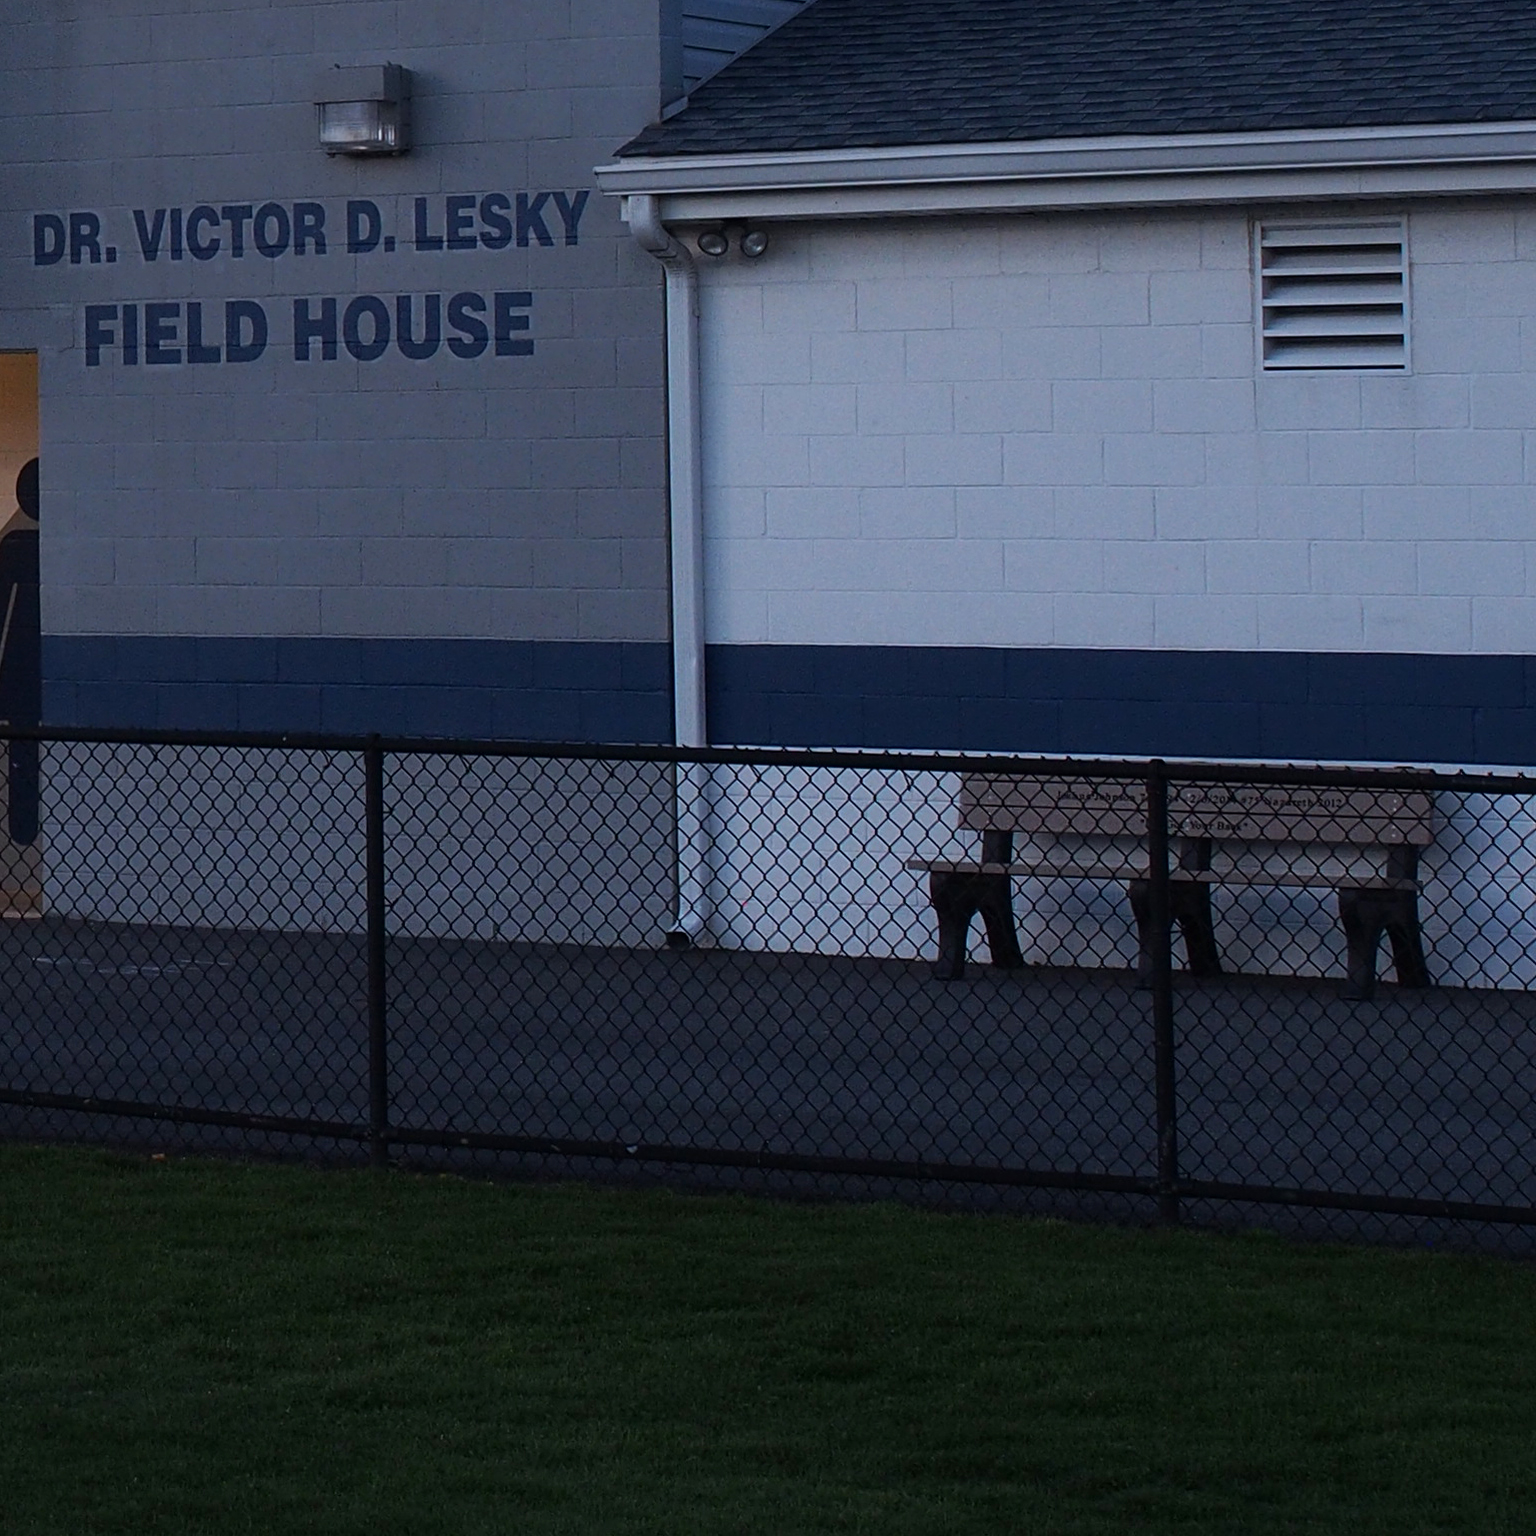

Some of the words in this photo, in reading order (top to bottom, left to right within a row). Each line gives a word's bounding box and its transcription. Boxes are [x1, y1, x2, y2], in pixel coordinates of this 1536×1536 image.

[34, 213, 117, 265] DR.
[134, 202, 326, 262] VICTOR
[347, 199, 395, 254] D.
[415, 190, 590, 251] LESKY
[85, 300, 268, 366] FIELD
[294, 291, 535, 362] HOUSE
